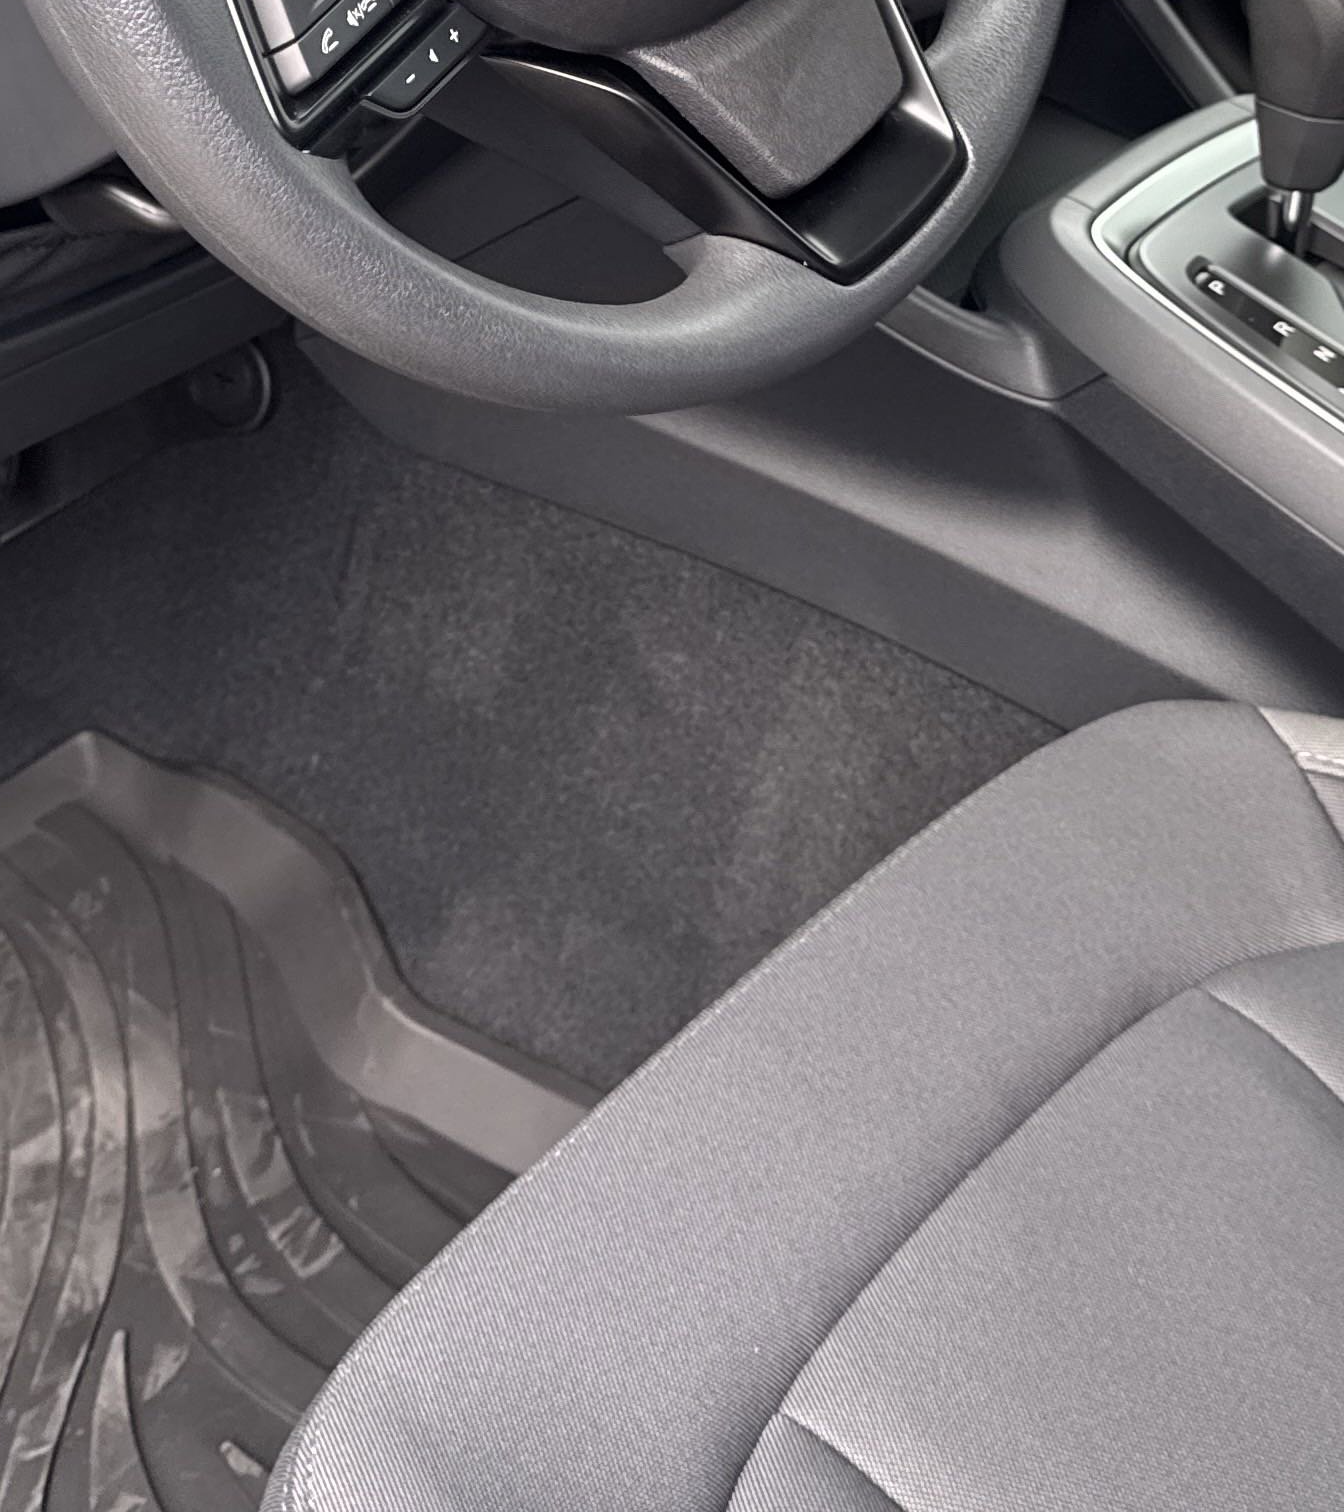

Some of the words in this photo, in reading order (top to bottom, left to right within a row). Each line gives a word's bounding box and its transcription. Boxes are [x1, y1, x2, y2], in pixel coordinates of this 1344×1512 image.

[1208, 279, 1226, 296] P
[1272, 319, 1297, 338] R
[1312, 345, 1337, 363] N
